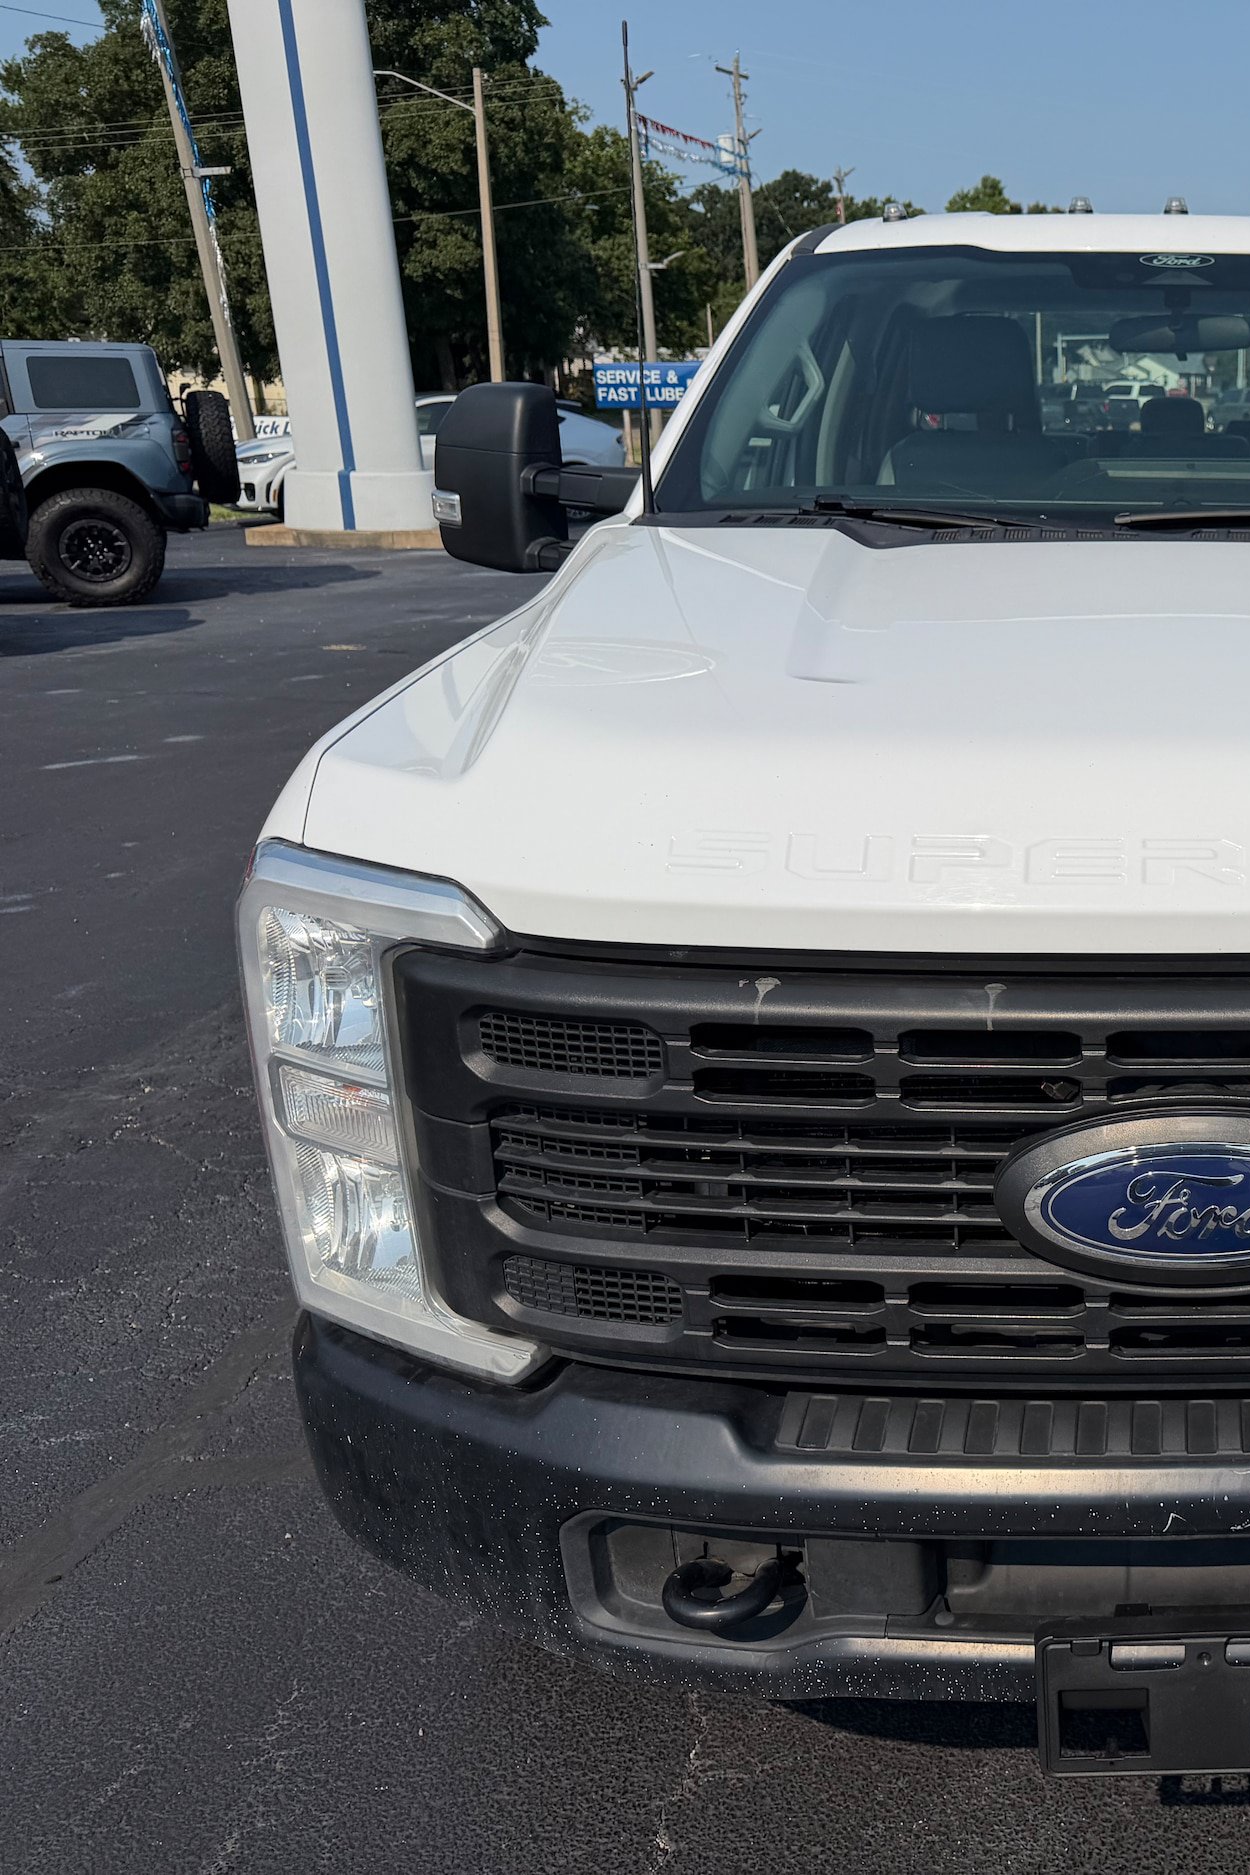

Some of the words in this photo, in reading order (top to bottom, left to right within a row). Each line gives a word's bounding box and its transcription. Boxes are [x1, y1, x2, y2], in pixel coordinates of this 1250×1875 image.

[1152, 254, 1202, 267] Ford
[595, 369, 662, 385] SERVICE
[667, 369, 679, 385] &
[597, 386, 638, 402] FAST
[645, 386, 685, 402] LUBE
[664, 829, 1247, 886] SUPER
